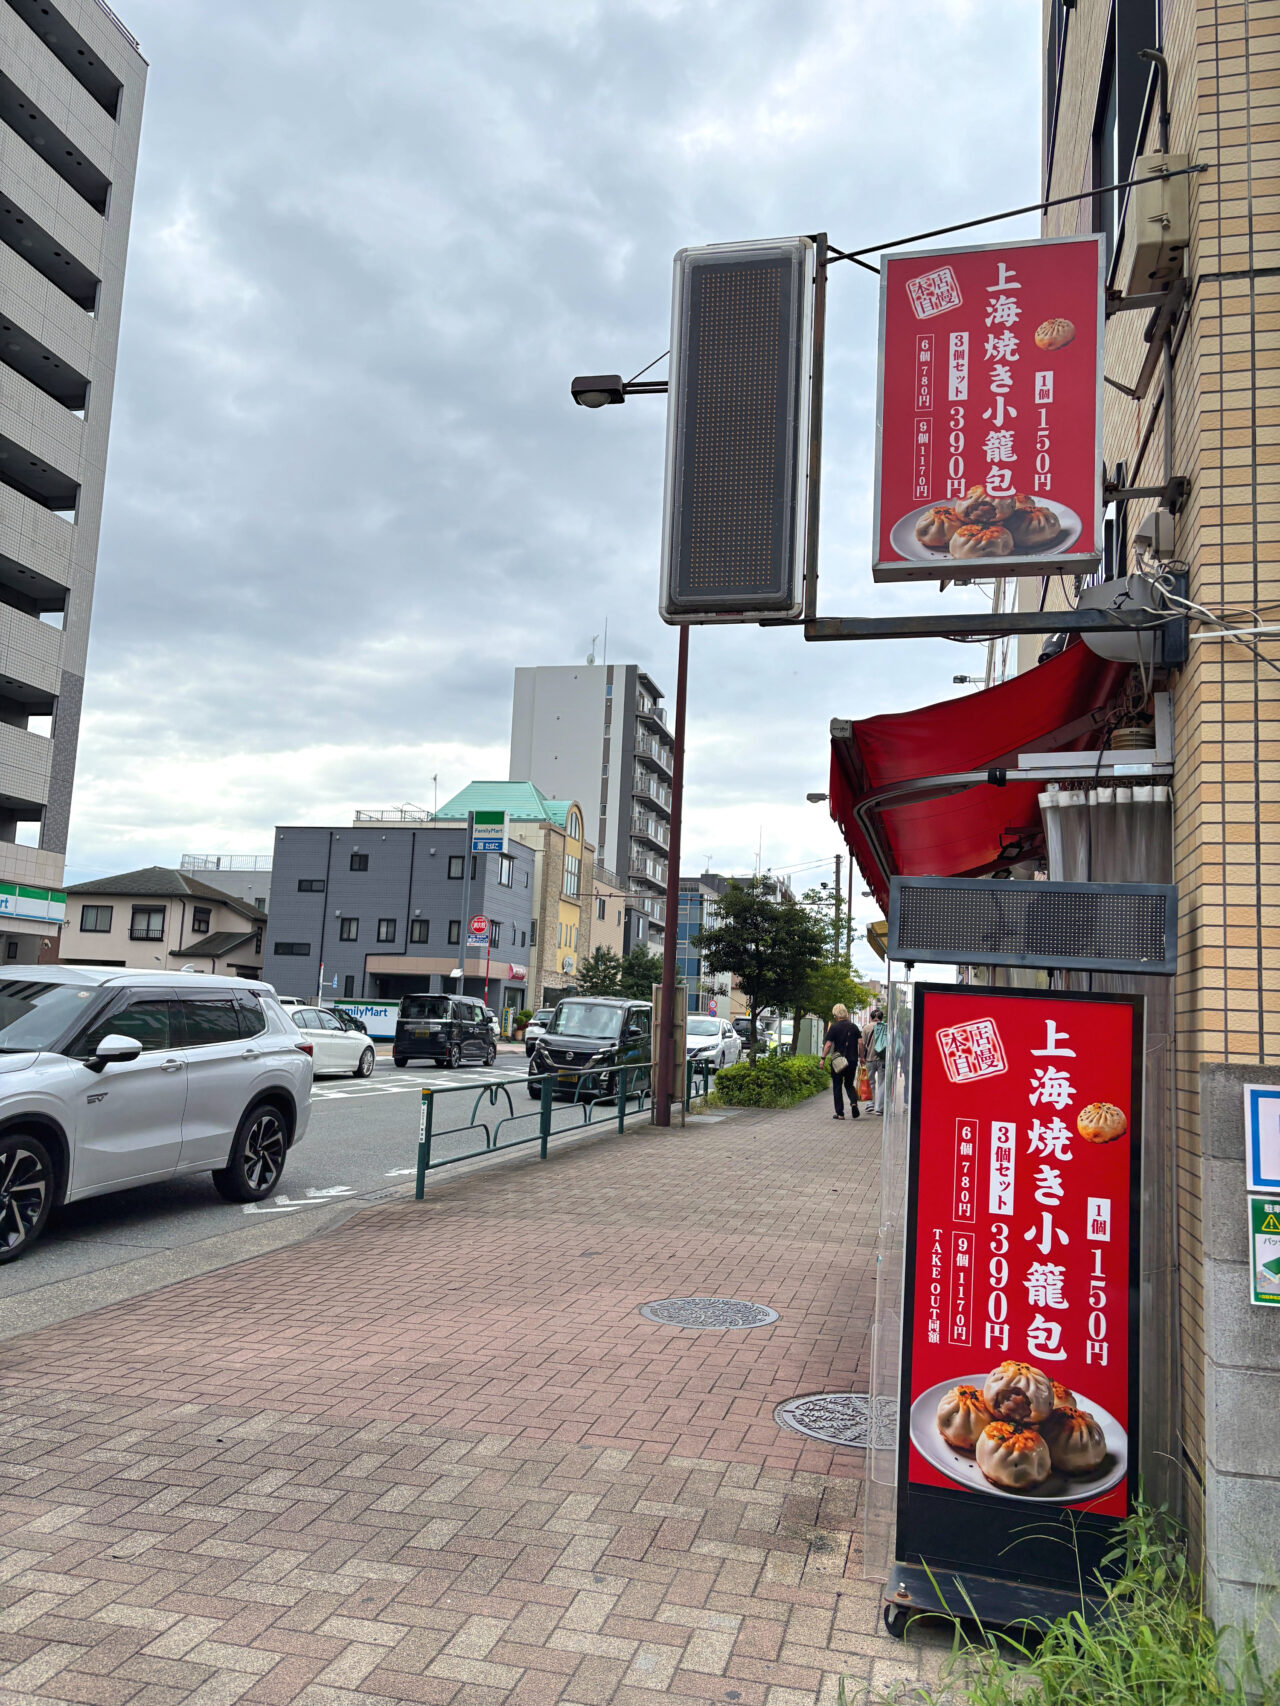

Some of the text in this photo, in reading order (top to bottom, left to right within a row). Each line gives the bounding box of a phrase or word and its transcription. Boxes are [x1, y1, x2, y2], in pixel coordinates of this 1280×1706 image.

[918, 339, 931, 407] 6個 780円
[947, 333, 966, 498] 3個セット 390円
[982, 262, 1022, 498] 上海焼き小籠包
[1034, 374, 1052, 491] 1個 150円
[916, 421, 929, 497] 9個 1170円
[957, 1126, 973, 1218] 6個 780円
[985, 1126, 1013, 1352] 3個セット 390円
[1023, 1019, 1078, 1362] 上海焼き小籠包
[953, 1237, 969, 1341] 9個 1170円
[1086, 1203, 1109, 1367] 1個 150円
